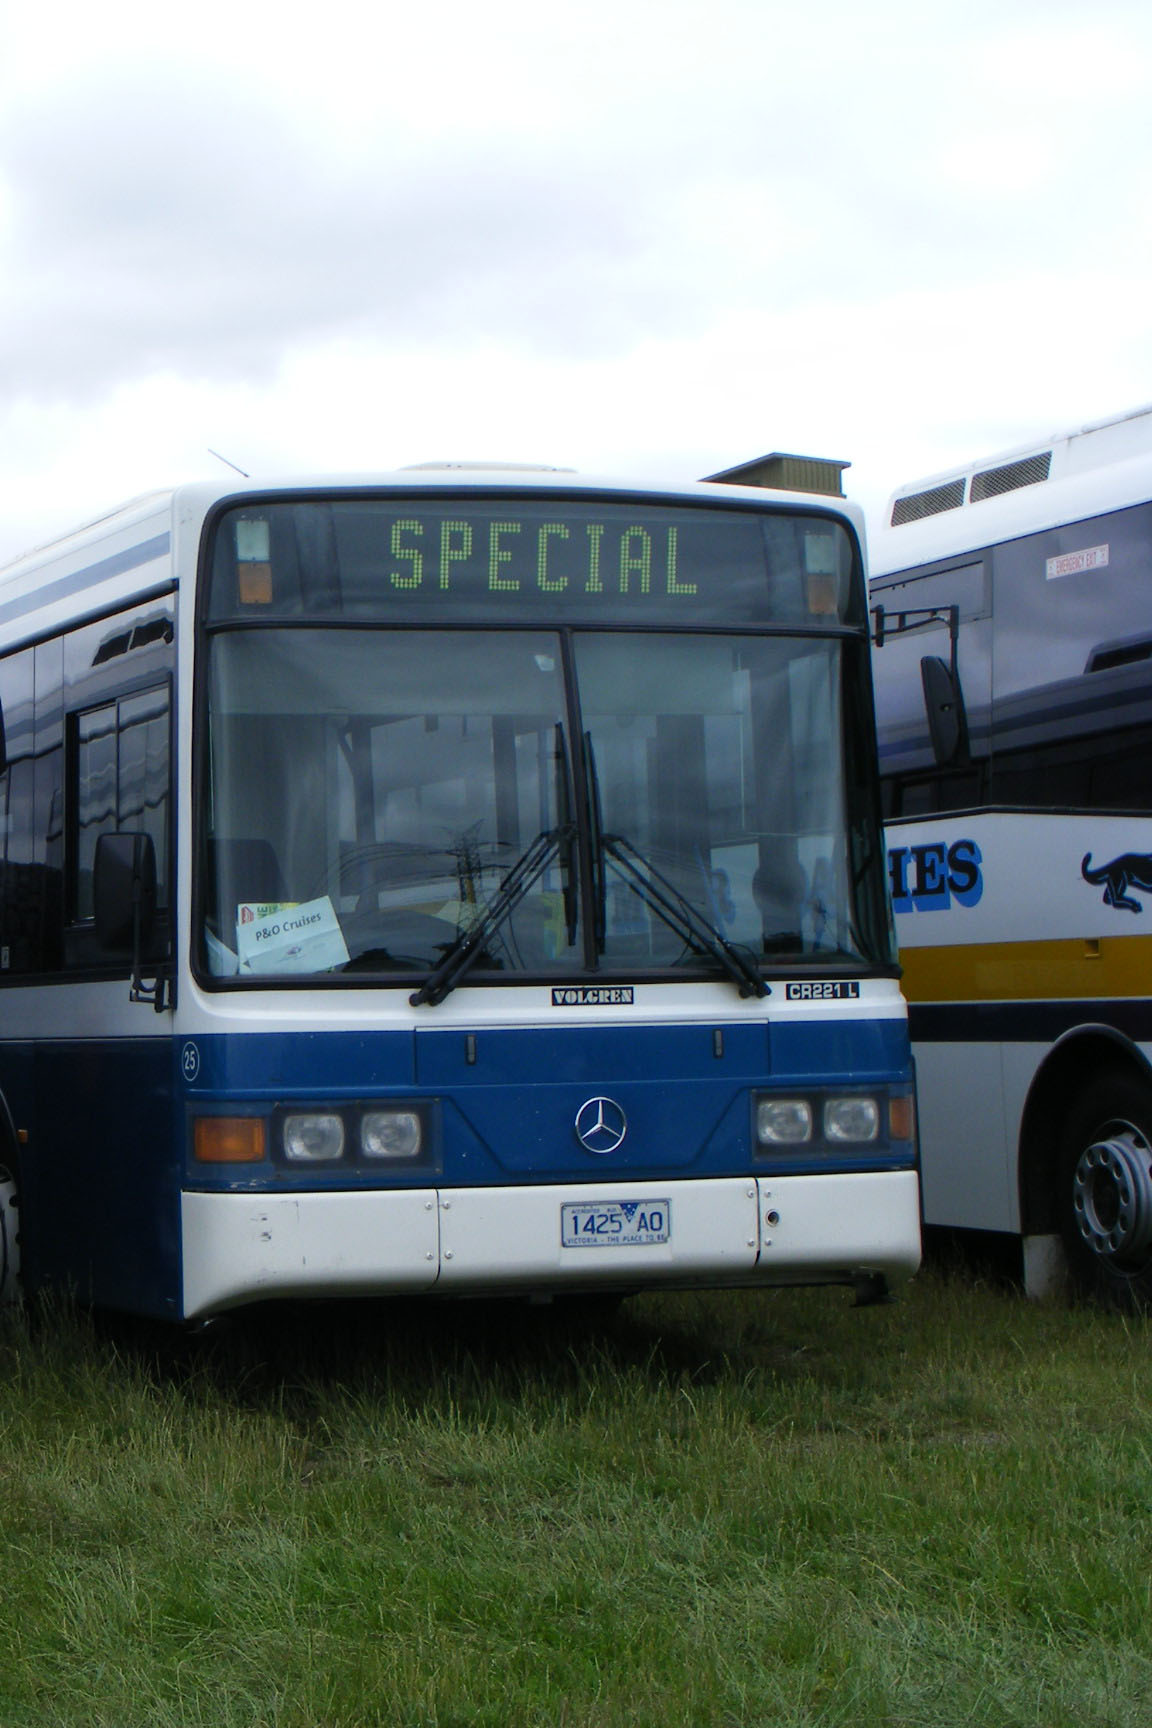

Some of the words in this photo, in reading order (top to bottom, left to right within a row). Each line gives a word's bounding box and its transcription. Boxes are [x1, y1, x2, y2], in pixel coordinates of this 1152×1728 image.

[390, 518, 698, 595] SPECIAL
[255, 924, 281, 941] P&O
[282, 912, 322, 933] Cruises
[553, 988, 633, 1005] VOLGREN
[789, 983, 841, 999] CR221
[848, 982, 857, 998] L
[184, 1050, 196, 1070] 25
[572, 1212, 623, 1236] 1425
